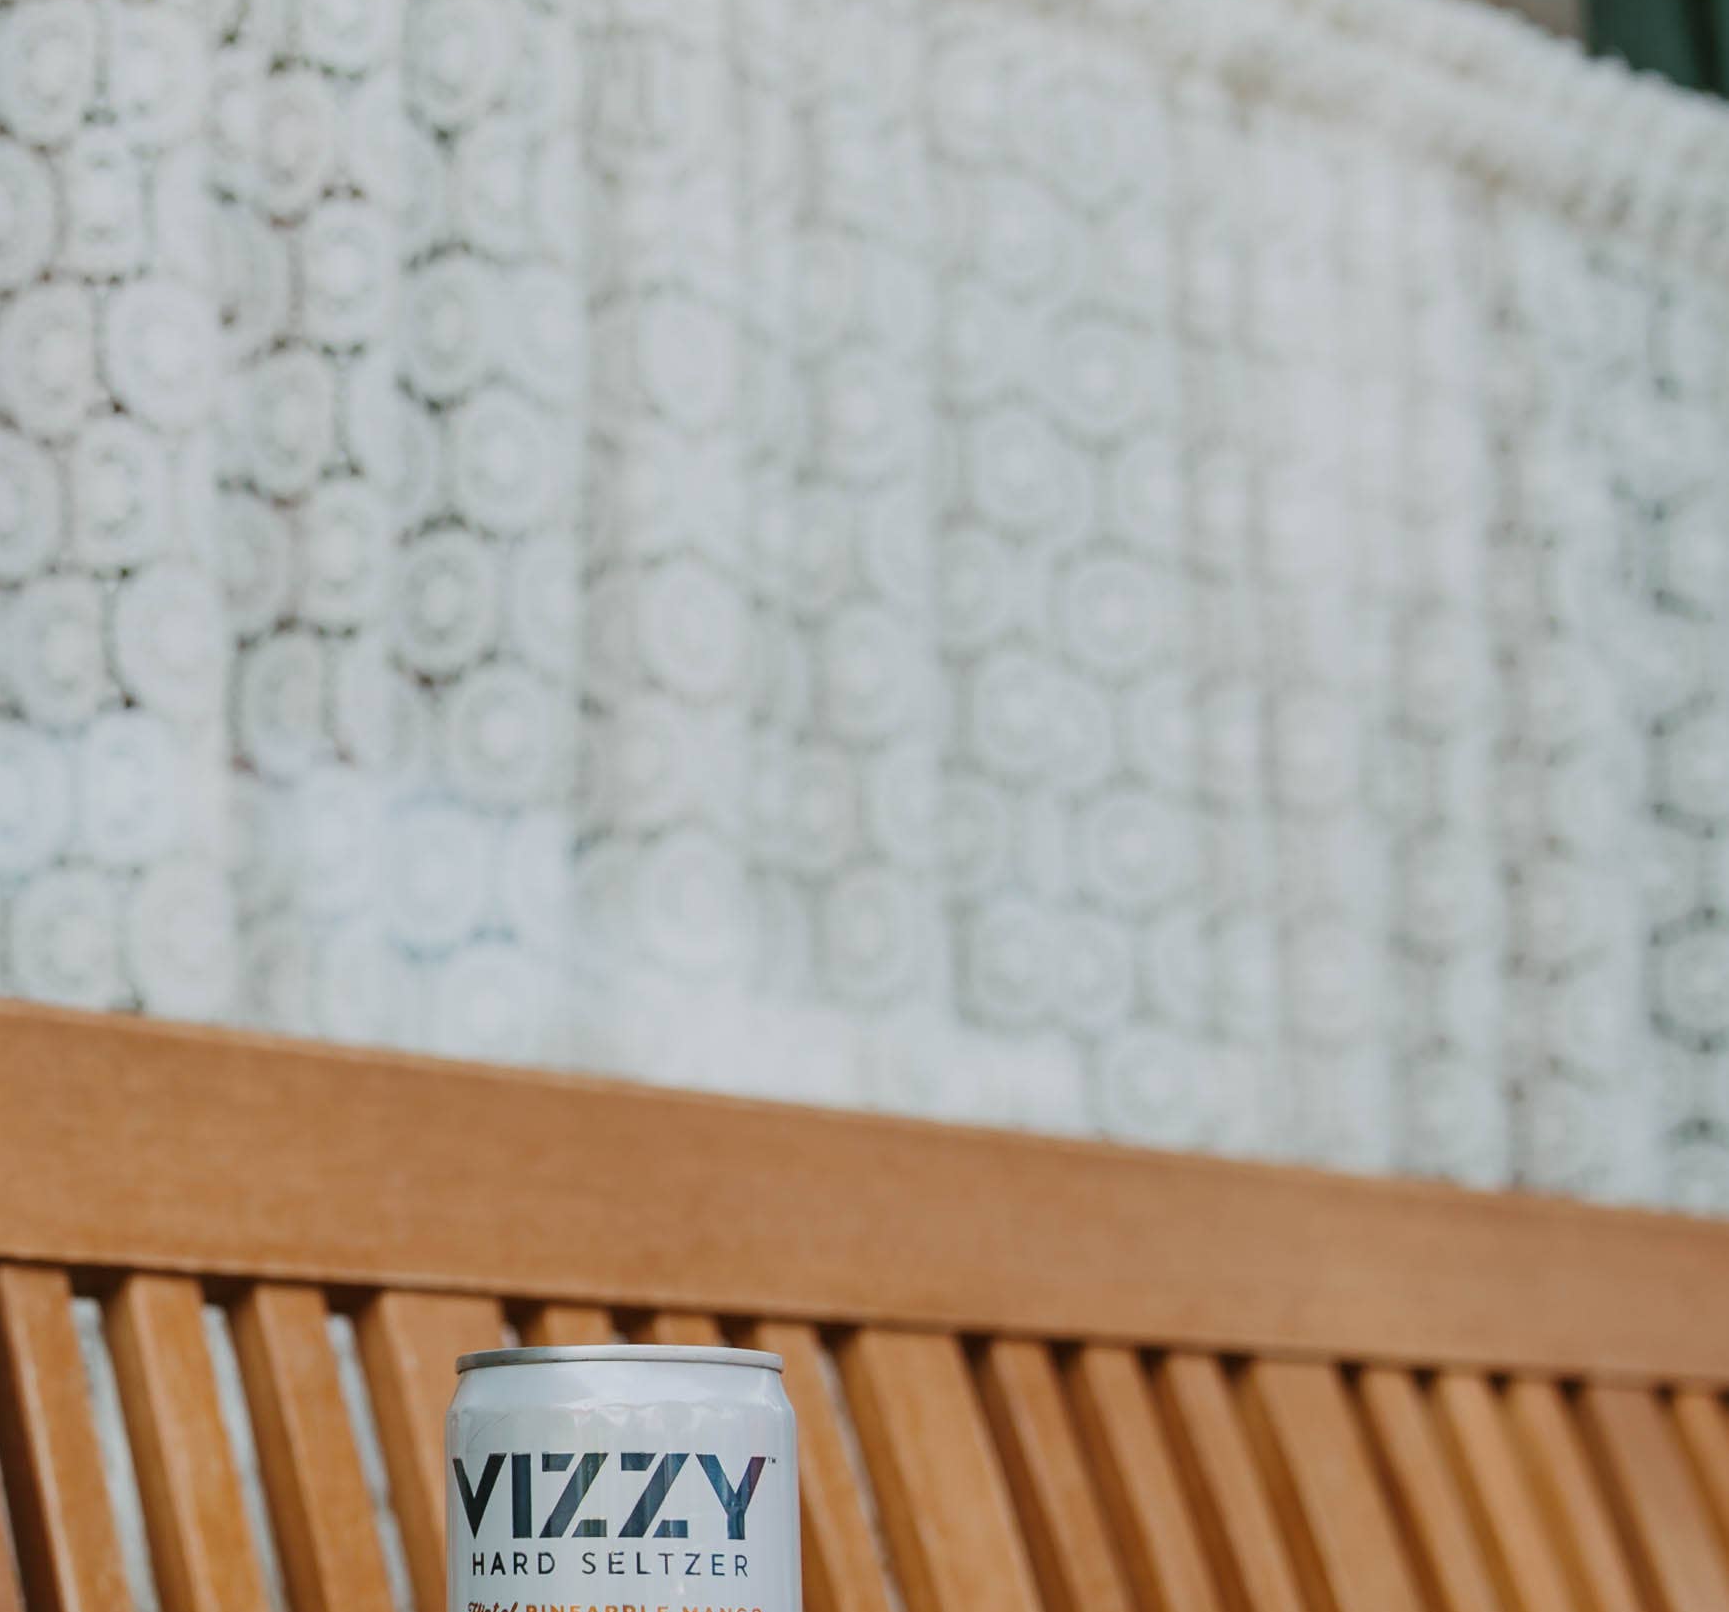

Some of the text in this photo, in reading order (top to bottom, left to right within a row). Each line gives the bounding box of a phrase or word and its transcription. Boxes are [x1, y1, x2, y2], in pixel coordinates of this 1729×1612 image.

[452, 1452, 767, 1540] VIZZY
[472, 1551, 749, 1577] HARD SELTZER
